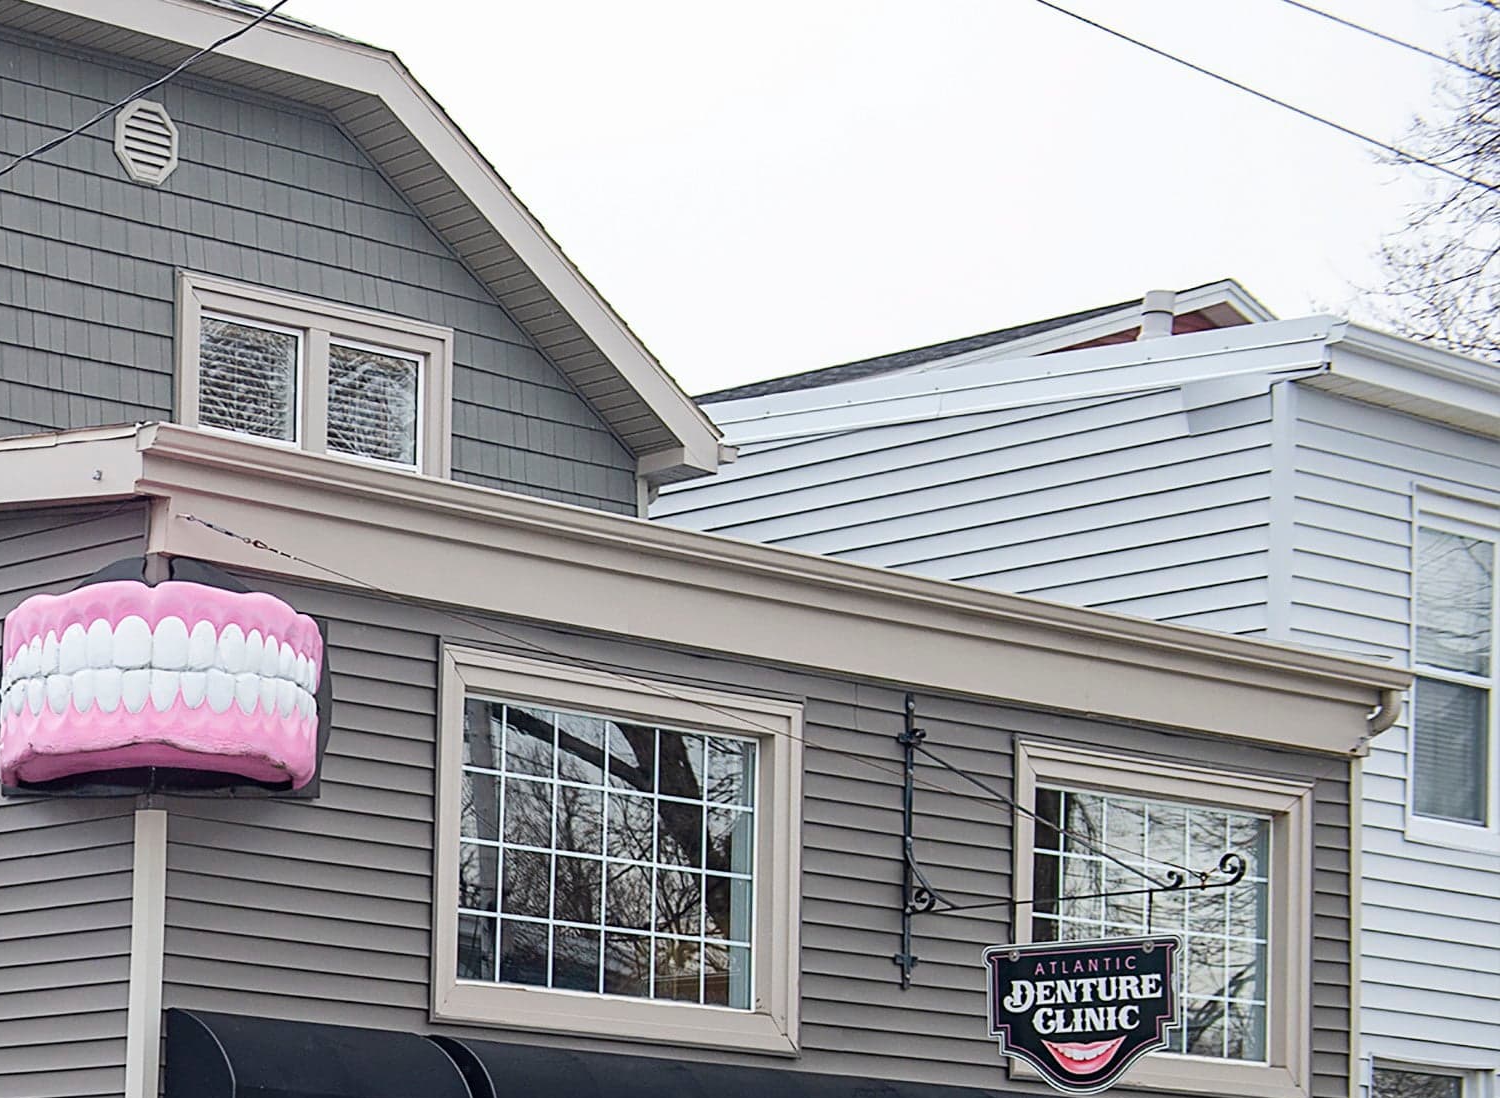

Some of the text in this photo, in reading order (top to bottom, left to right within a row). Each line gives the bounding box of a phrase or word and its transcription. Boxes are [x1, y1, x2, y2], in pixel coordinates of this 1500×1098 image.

[1034, 955, 1137, 976] ATLANTIC
[1003, 974, 1163, 1013] DENTURE
[1032, 1005, 1140, 1035] CLINIC
